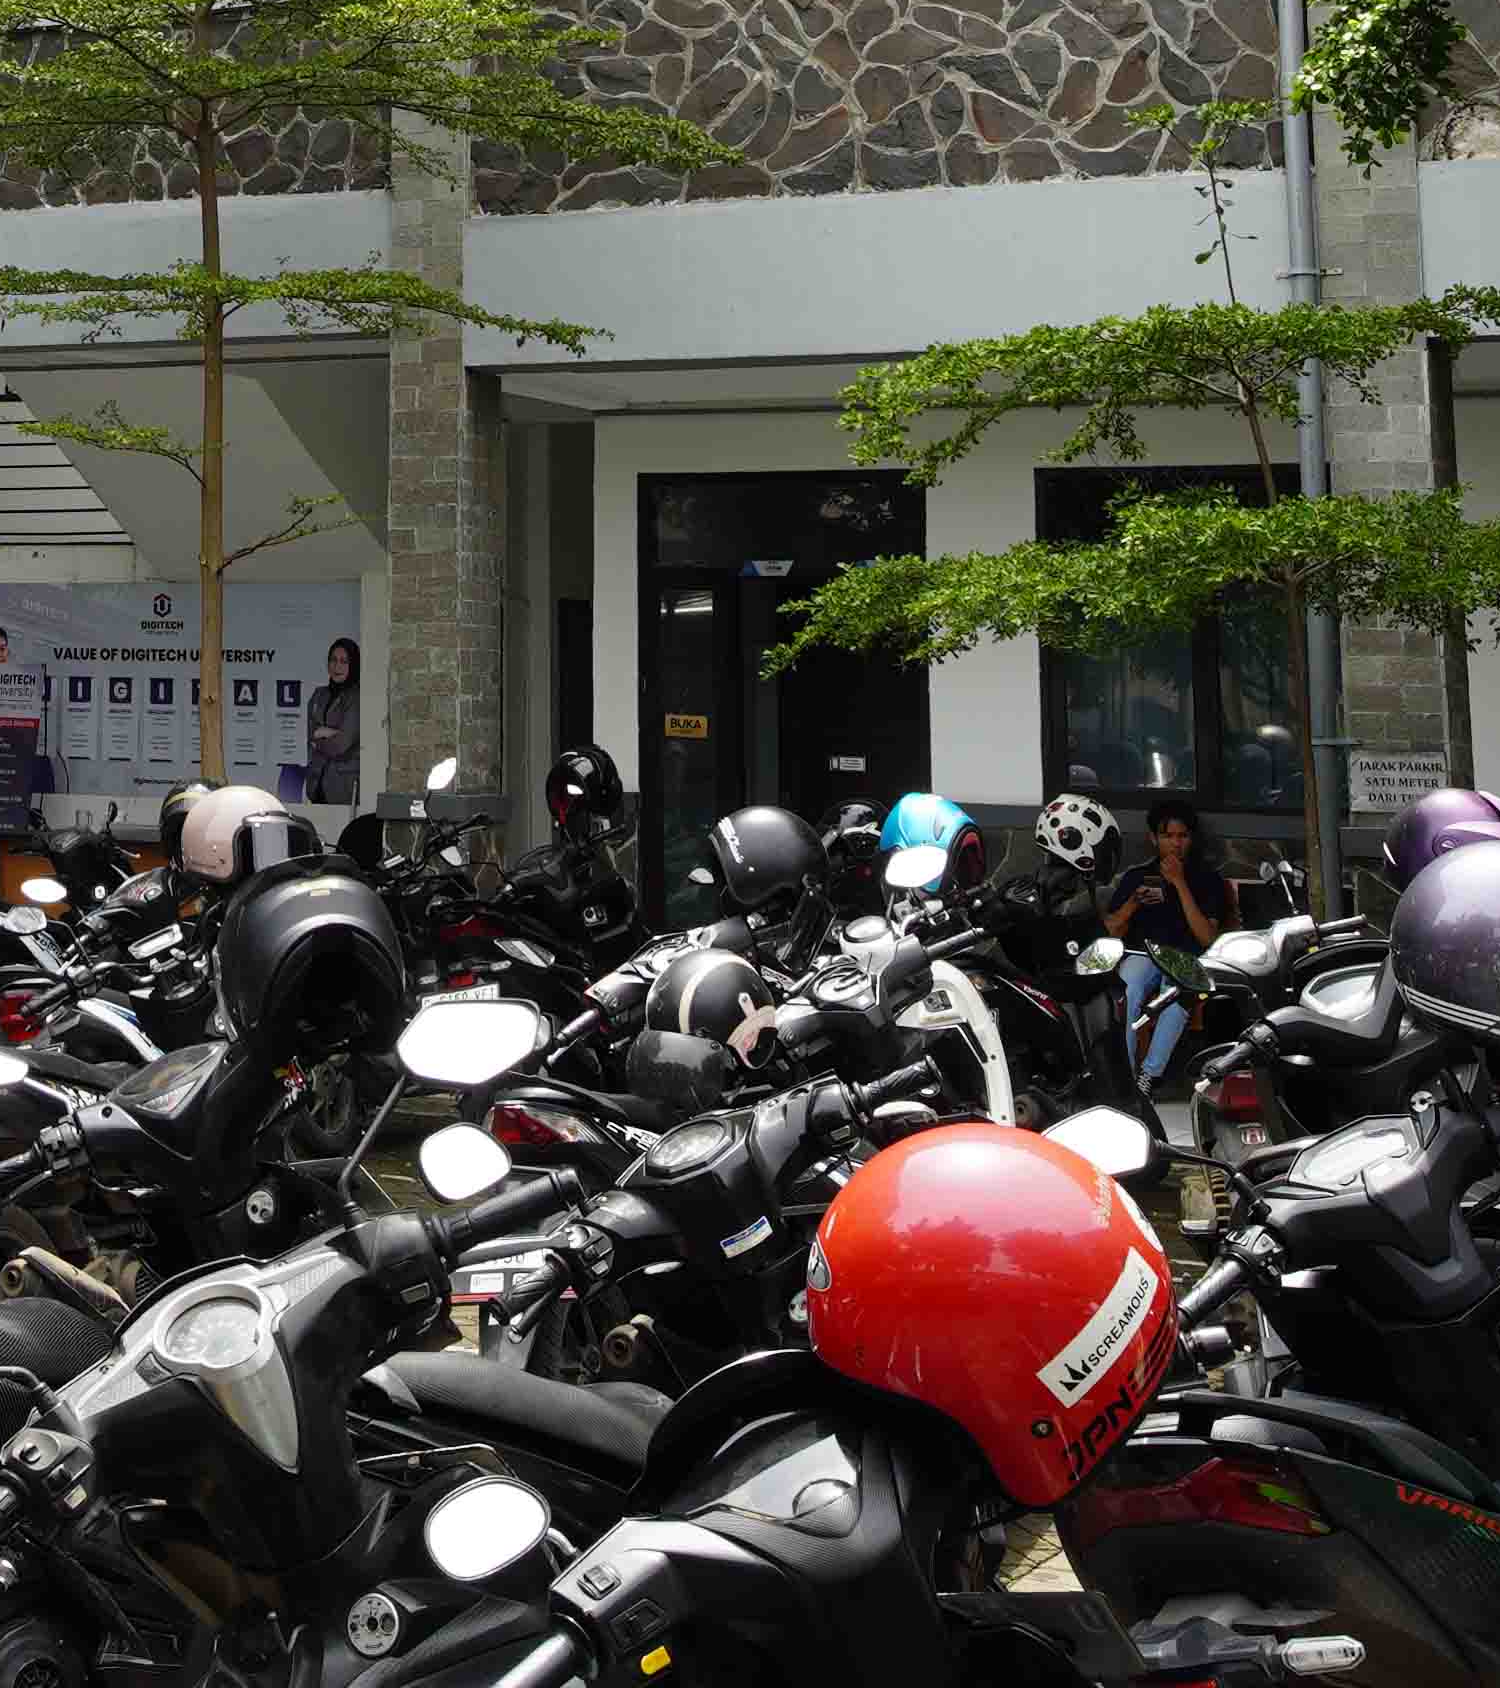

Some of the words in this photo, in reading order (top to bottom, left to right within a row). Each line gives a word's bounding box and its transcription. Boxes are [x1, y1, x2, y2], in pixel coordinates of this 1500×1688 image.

[140, 620, 184, 631] DIGITECH
[54, 647, 97, 661] VALUE
[99, 648, 119, 662] OF
[121, 649, 188, 663] DIGITECH
[113, 681, 128, 700] G
[238, 684, 254, 703] A
[283, 684, 295, 703] L
[670, 718, 703, 729] BUKA
[1360, 761, 1398, 772] JARAK
[1400, 761, 1445, 774] PARKIR
[1366, 776, 1396, 787] SATU
[1399, 777, 1440, 789] METER
[1369, 792, 1397, 803] DARI
[1087, 1276, 1150, 1367] SCREAMOUS
[1066, 1380, 1133, 1481] JPN
